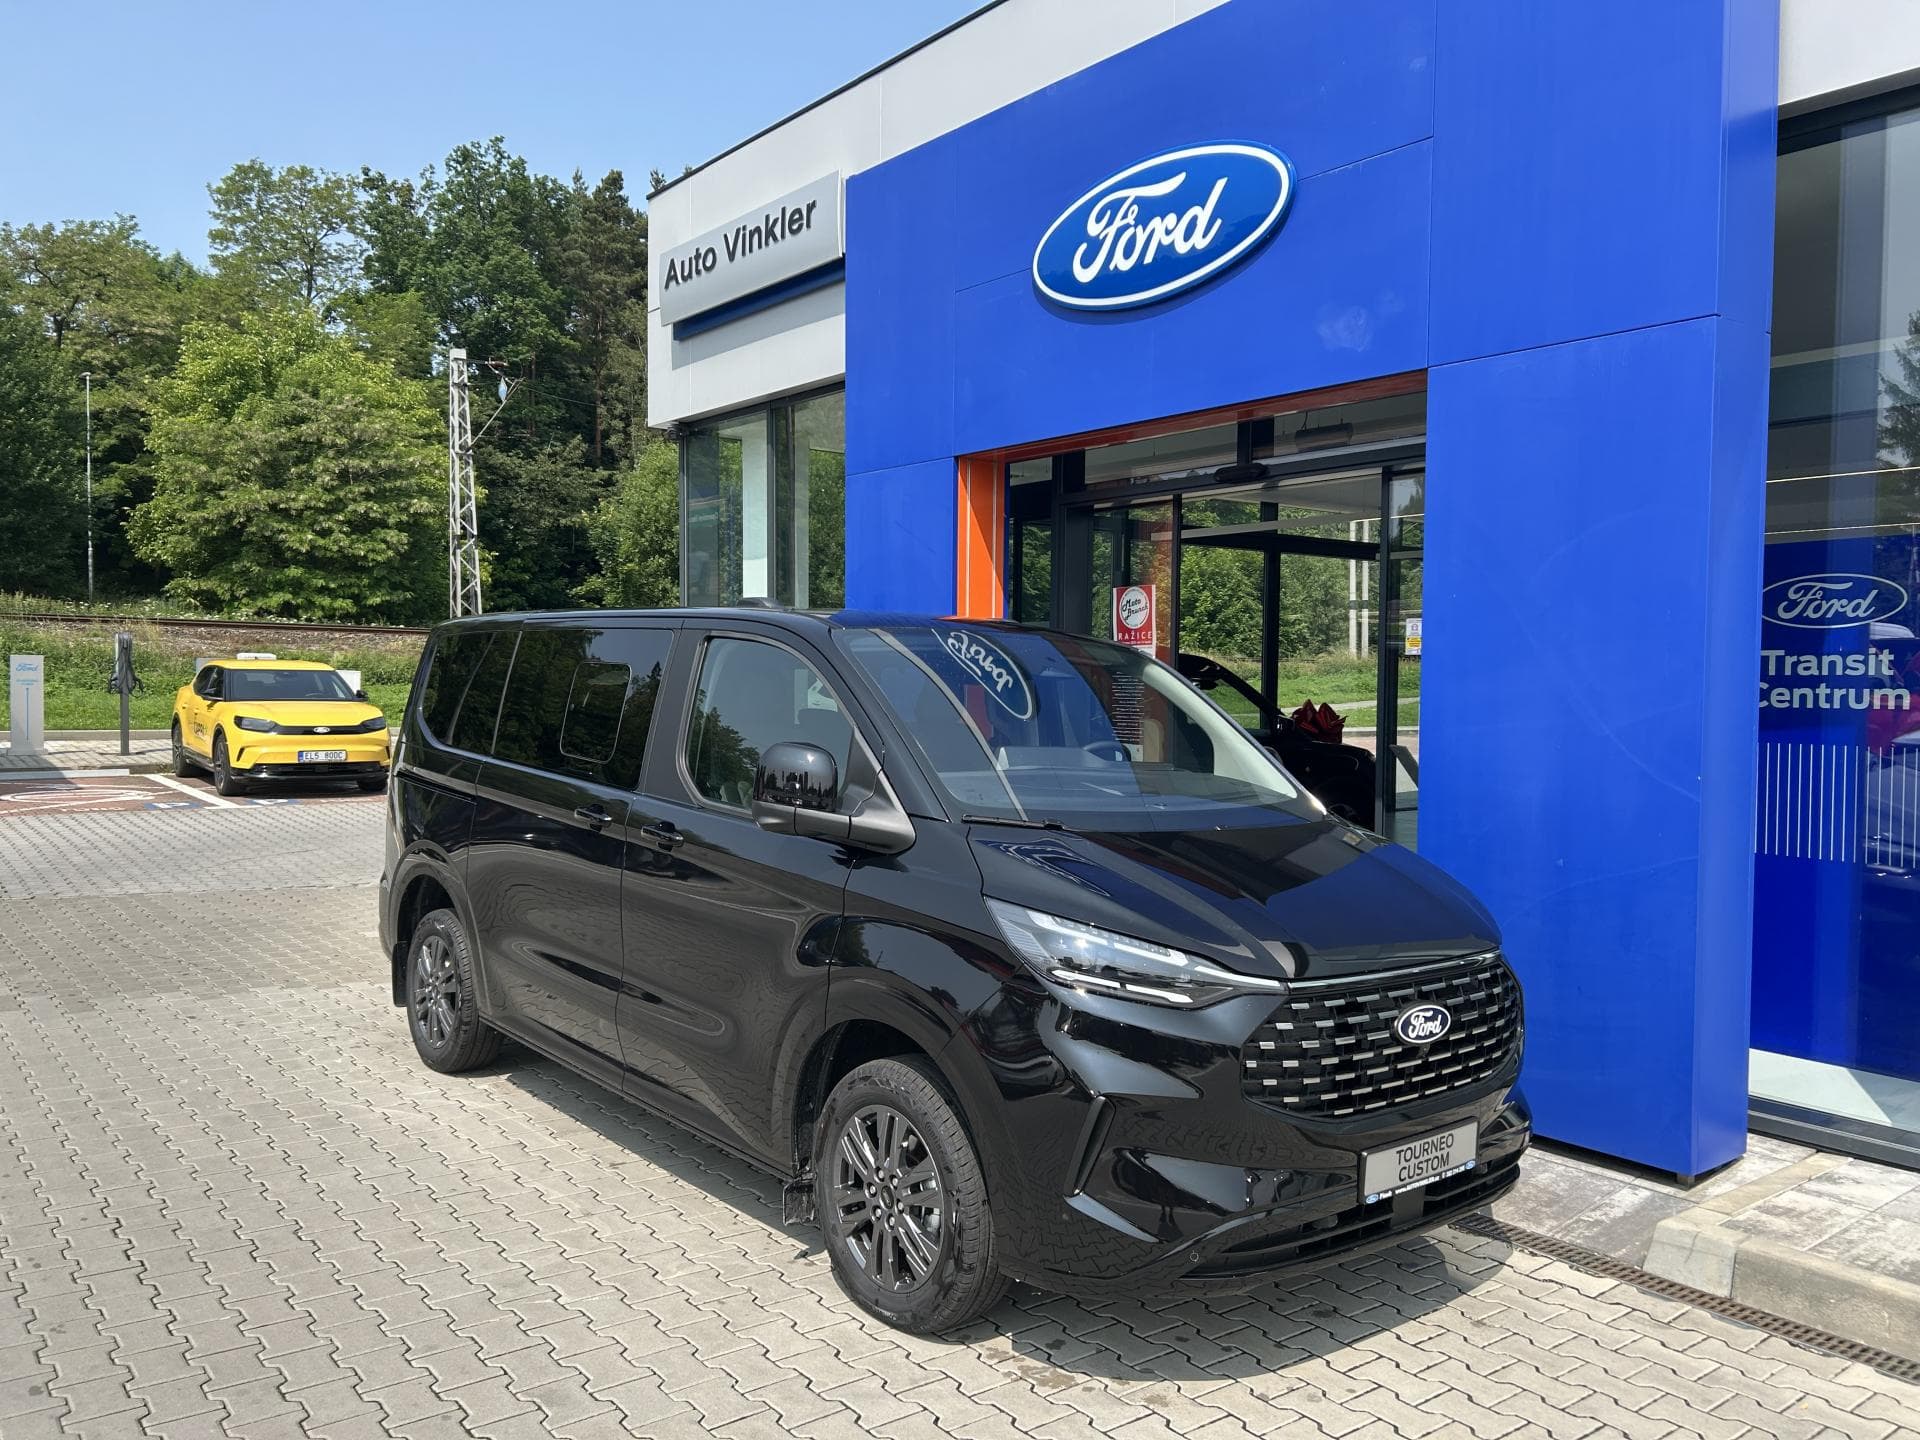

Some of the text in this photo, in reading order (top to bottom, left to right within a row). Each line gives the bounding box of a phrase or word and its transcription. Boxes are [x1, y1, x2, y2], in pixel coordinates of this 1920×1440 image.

[1073, 171, 1228, 283] Ford
[664, 199, 817, 290] Auto Vinkler
[1777, 581, 1879, 619] Ford
[1760, 647, 1895, 676] Transit
[1408, 1010, 1442, 1038] Ford
[1396, 1133, 1454, 1165] TOURNEO
[1398, 1151, 1450, 1182] CUSTOM
